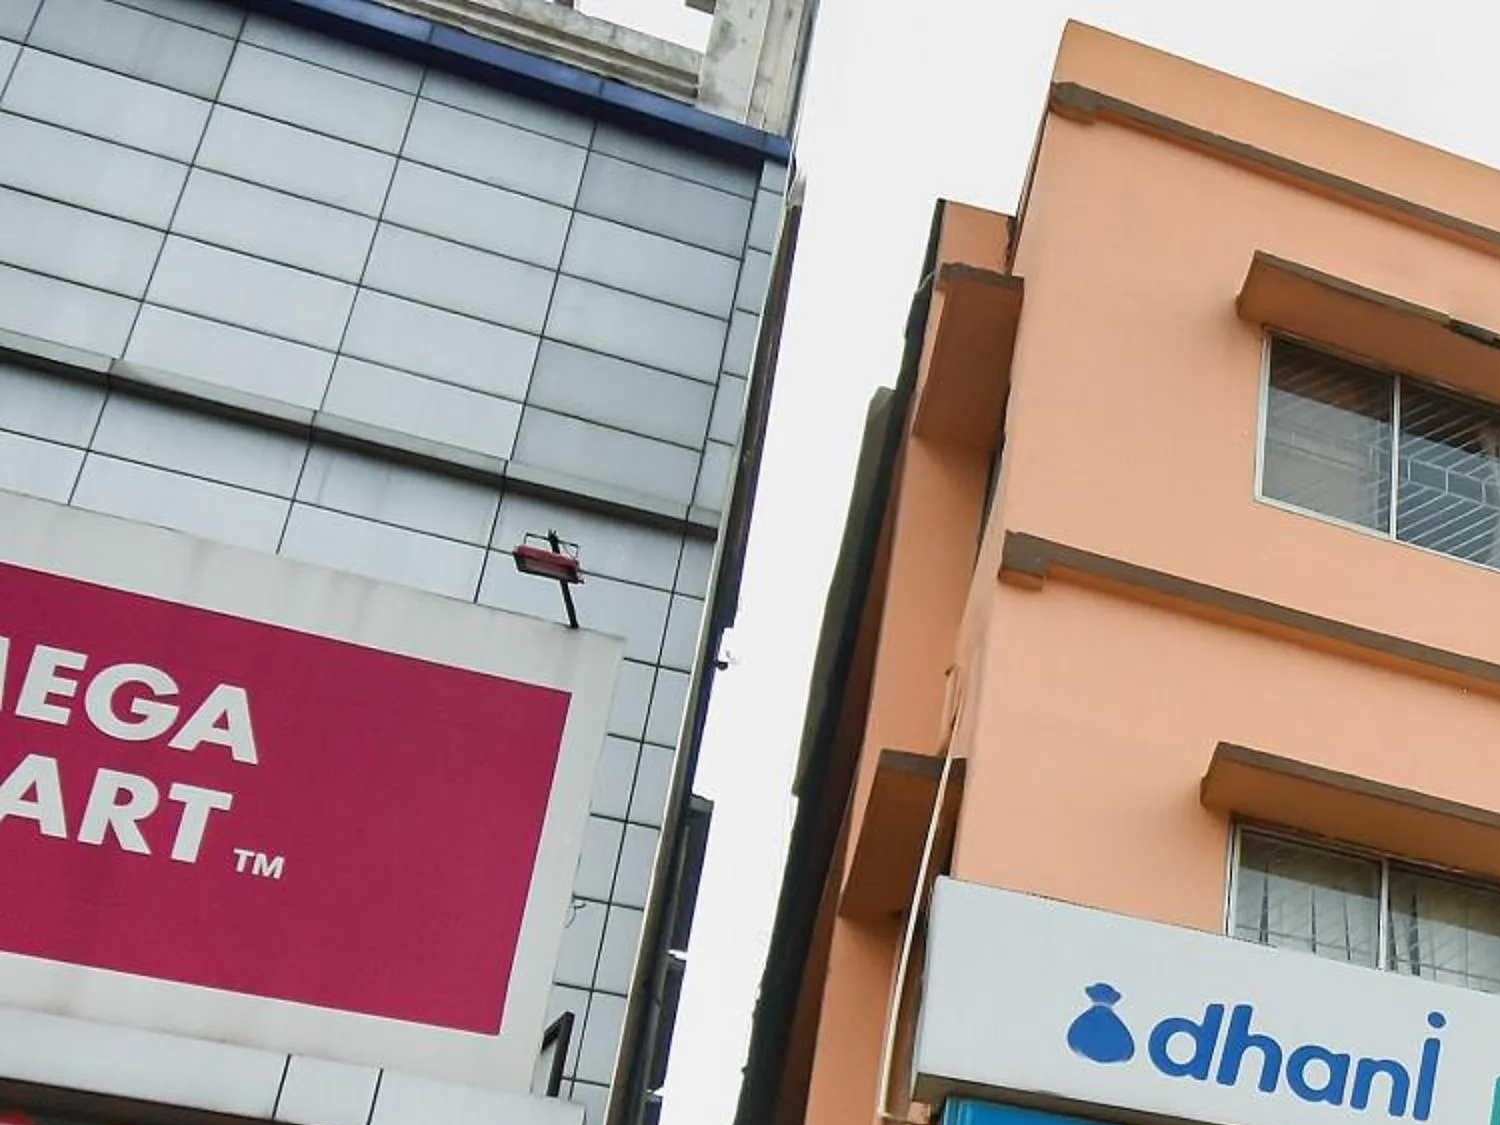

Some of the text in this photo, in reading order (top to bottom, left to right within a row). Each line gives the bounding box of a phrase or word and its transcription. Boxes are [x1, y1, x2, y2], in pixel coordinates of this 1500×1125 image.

[0, 636, 258, 764] EGA
[0, 753, 285, 880] ART TM
[1147, 1003, 1448, 1122] dhani
